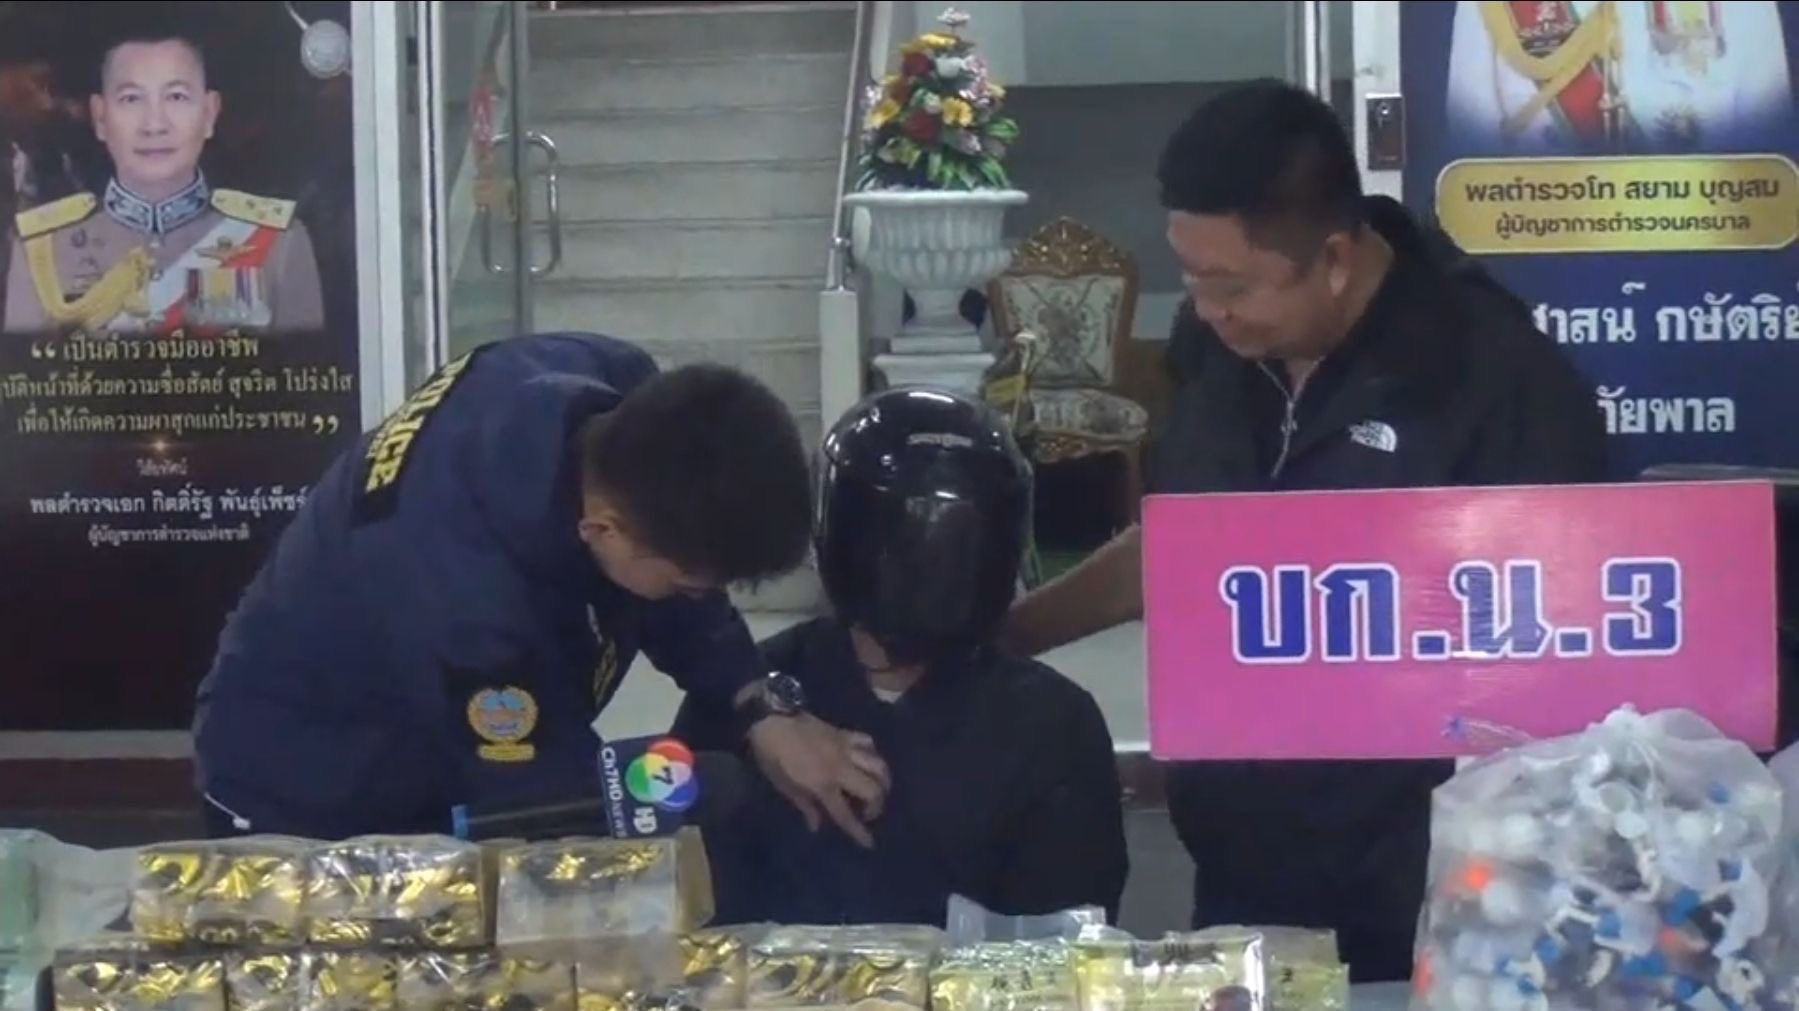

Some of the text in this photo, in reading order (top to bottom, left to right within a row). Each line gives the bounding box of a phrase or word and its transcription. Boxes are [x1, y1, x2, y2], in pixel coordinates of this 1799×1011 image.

[1464, 176, 1781, 204] พลตำรวจโท สยาม บุญสม
[1496, 212, 1751, 238] ผู้บัญชาการตำรวจนครบาล
[64, 329, 259, 361] เป็นตำรวจมืออาชีพ
[0, 363, 354, 400] บัติหน้าที่ด้วยความซื่อสัตย์ สุจริต โปร่งใส
[29, 491, 145, 514] พลตำรวจเอก
[1219, 556, 1684, 663] บก.น.3
